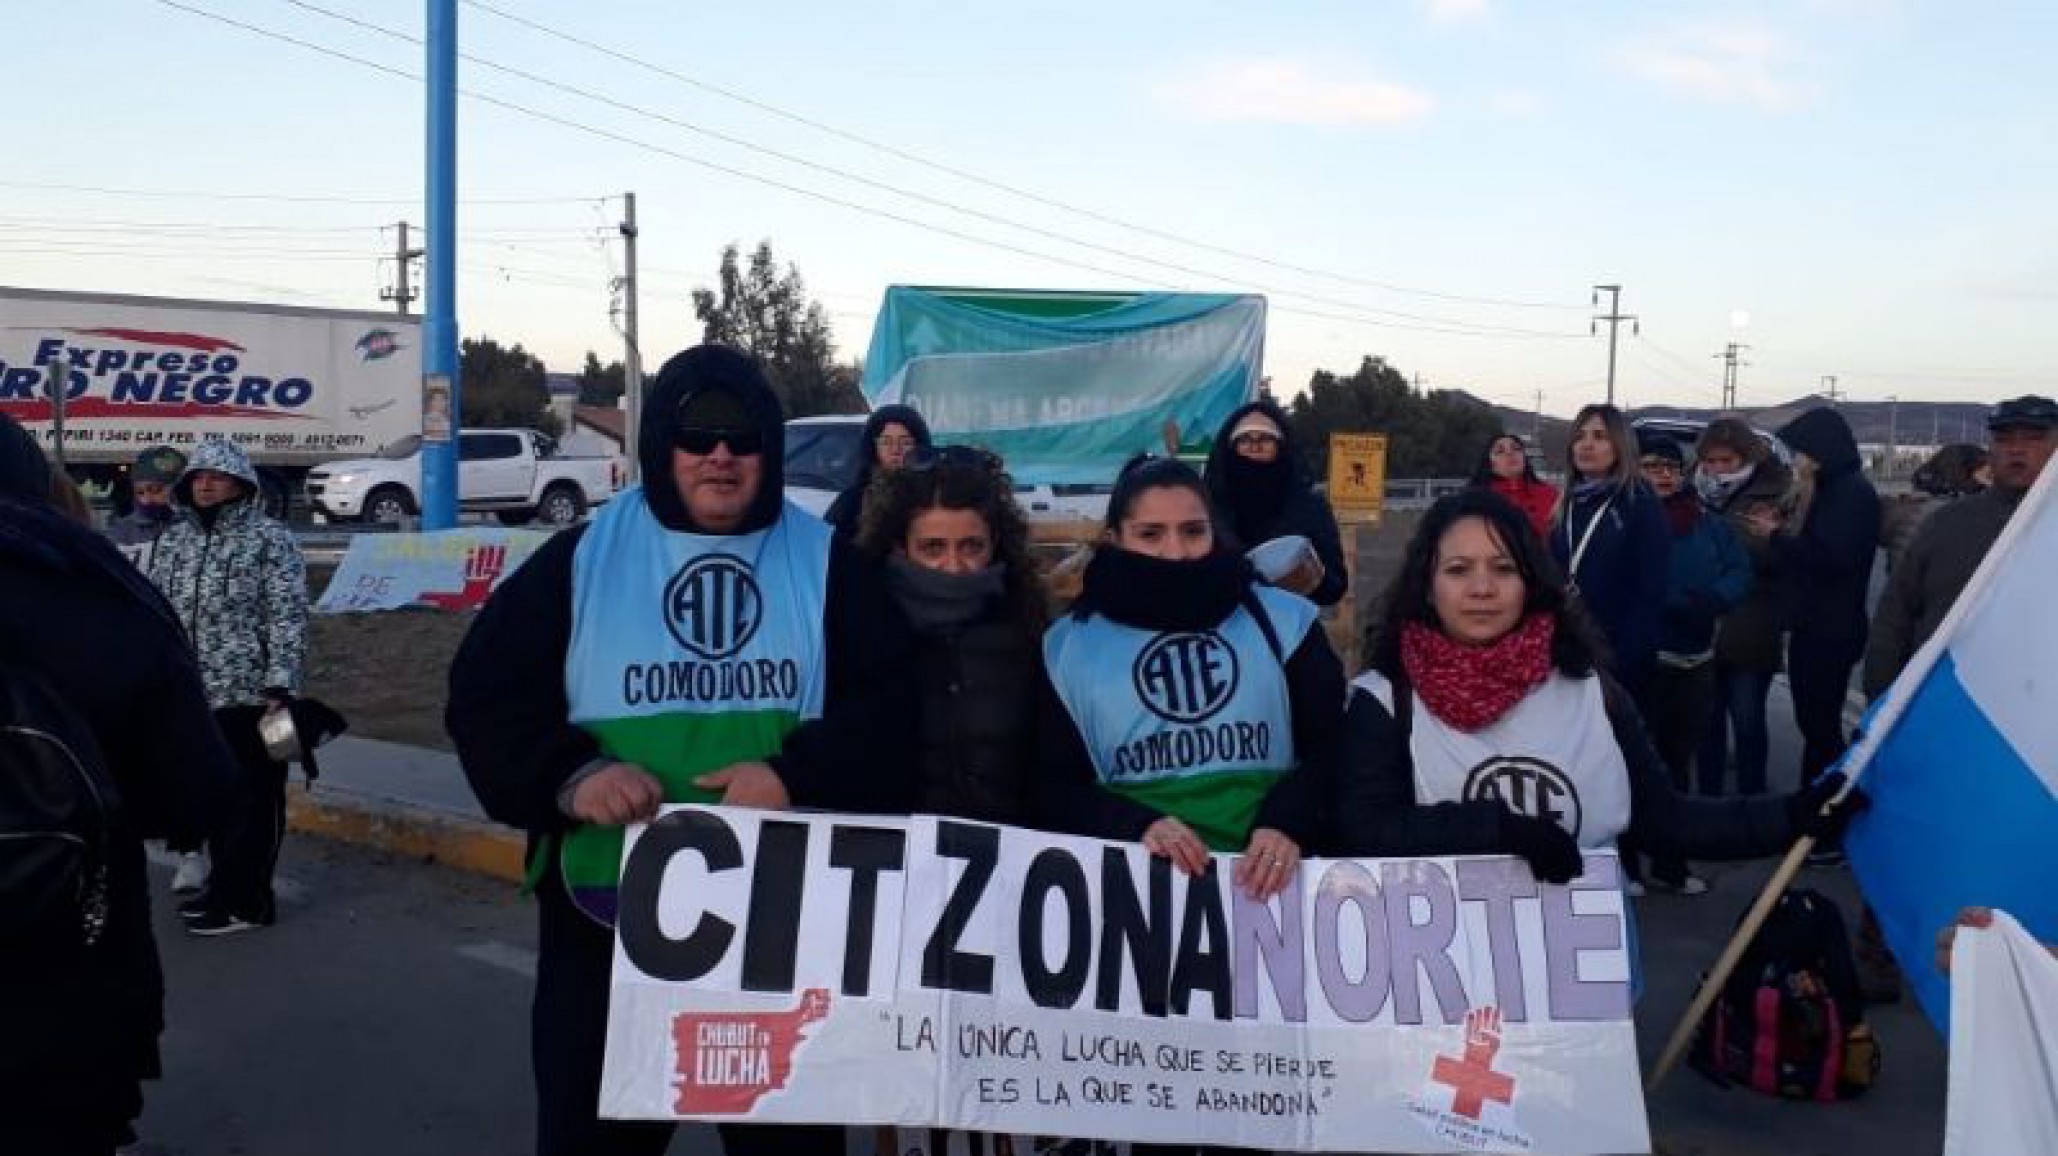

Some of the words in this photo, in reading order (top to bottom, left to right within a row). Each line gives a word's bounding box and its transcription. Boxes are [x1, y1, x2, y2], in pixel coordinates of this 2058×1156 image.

[34, 339, 240, 377] Expreso
[111, 370, 314, 408] NEGRO
[672, 561, 754, 653] ATE
[624, 658, 798, 706] COMODORO
[1138, 634, 1232, 716] ATE
[618, 809, 907, 998] CIT
[920, 820, 1233, 1021] ZONA
[1230, 855, 1630, 1026] NORTE
[696, 1047, 771, 1086] LUCHA
[1061, 1029, 1147, 1069] LUCHA
[1155, 1044, 1205, 1073] QUE
[1216, 1050, 1247, 1075] SE
[1253, 1051, 1337, 1080] PIERDE
[978, 1077, 1020, 1104] ES
[1035, 1075, 1072, 1107] LA
[1082, 1075, 1134, 1105] QUE
[1147, 1082, 1178, 1110] SE
